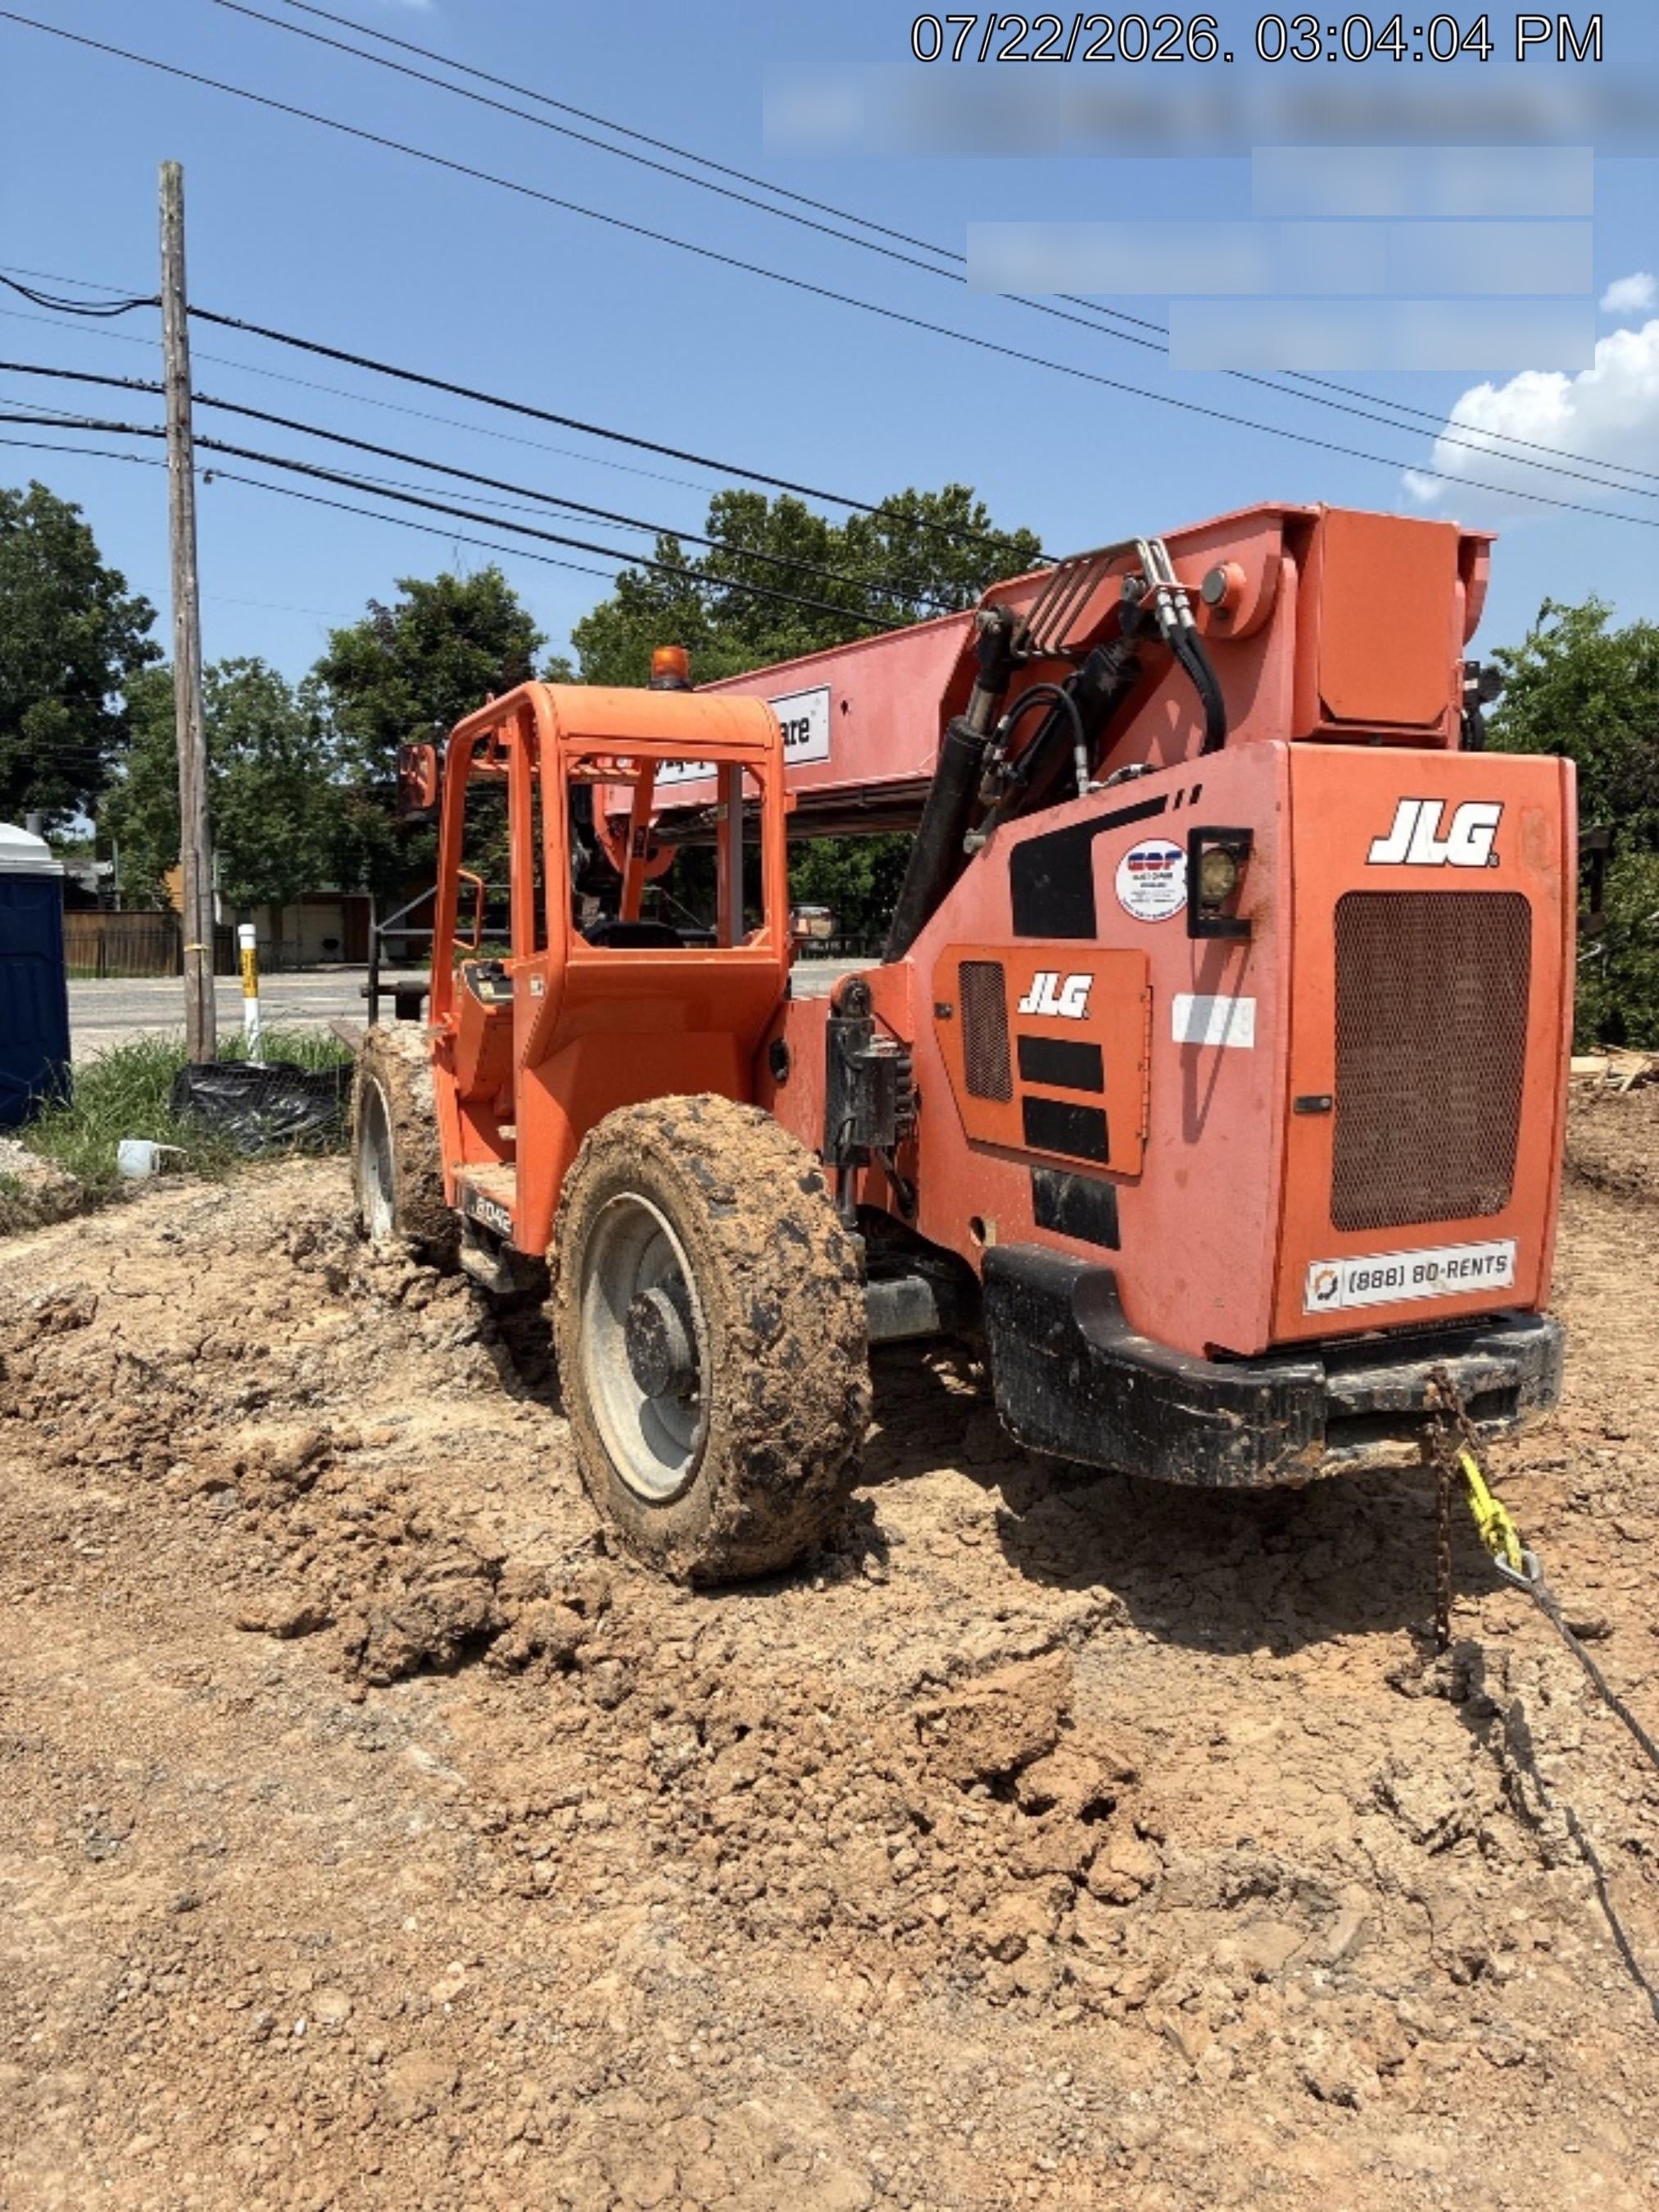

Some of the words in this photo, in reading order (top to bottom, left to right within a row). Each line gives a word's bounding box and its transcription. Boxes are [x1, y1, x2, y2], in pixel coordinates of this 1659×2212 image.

[1365, 796, 1504, 867] JLG
[1016, 971, 1095, 1020] JLG
[1349, 1265, 1405, 1293] (888)
[1412, 1254, 1507, 1284] 80-RENTS
